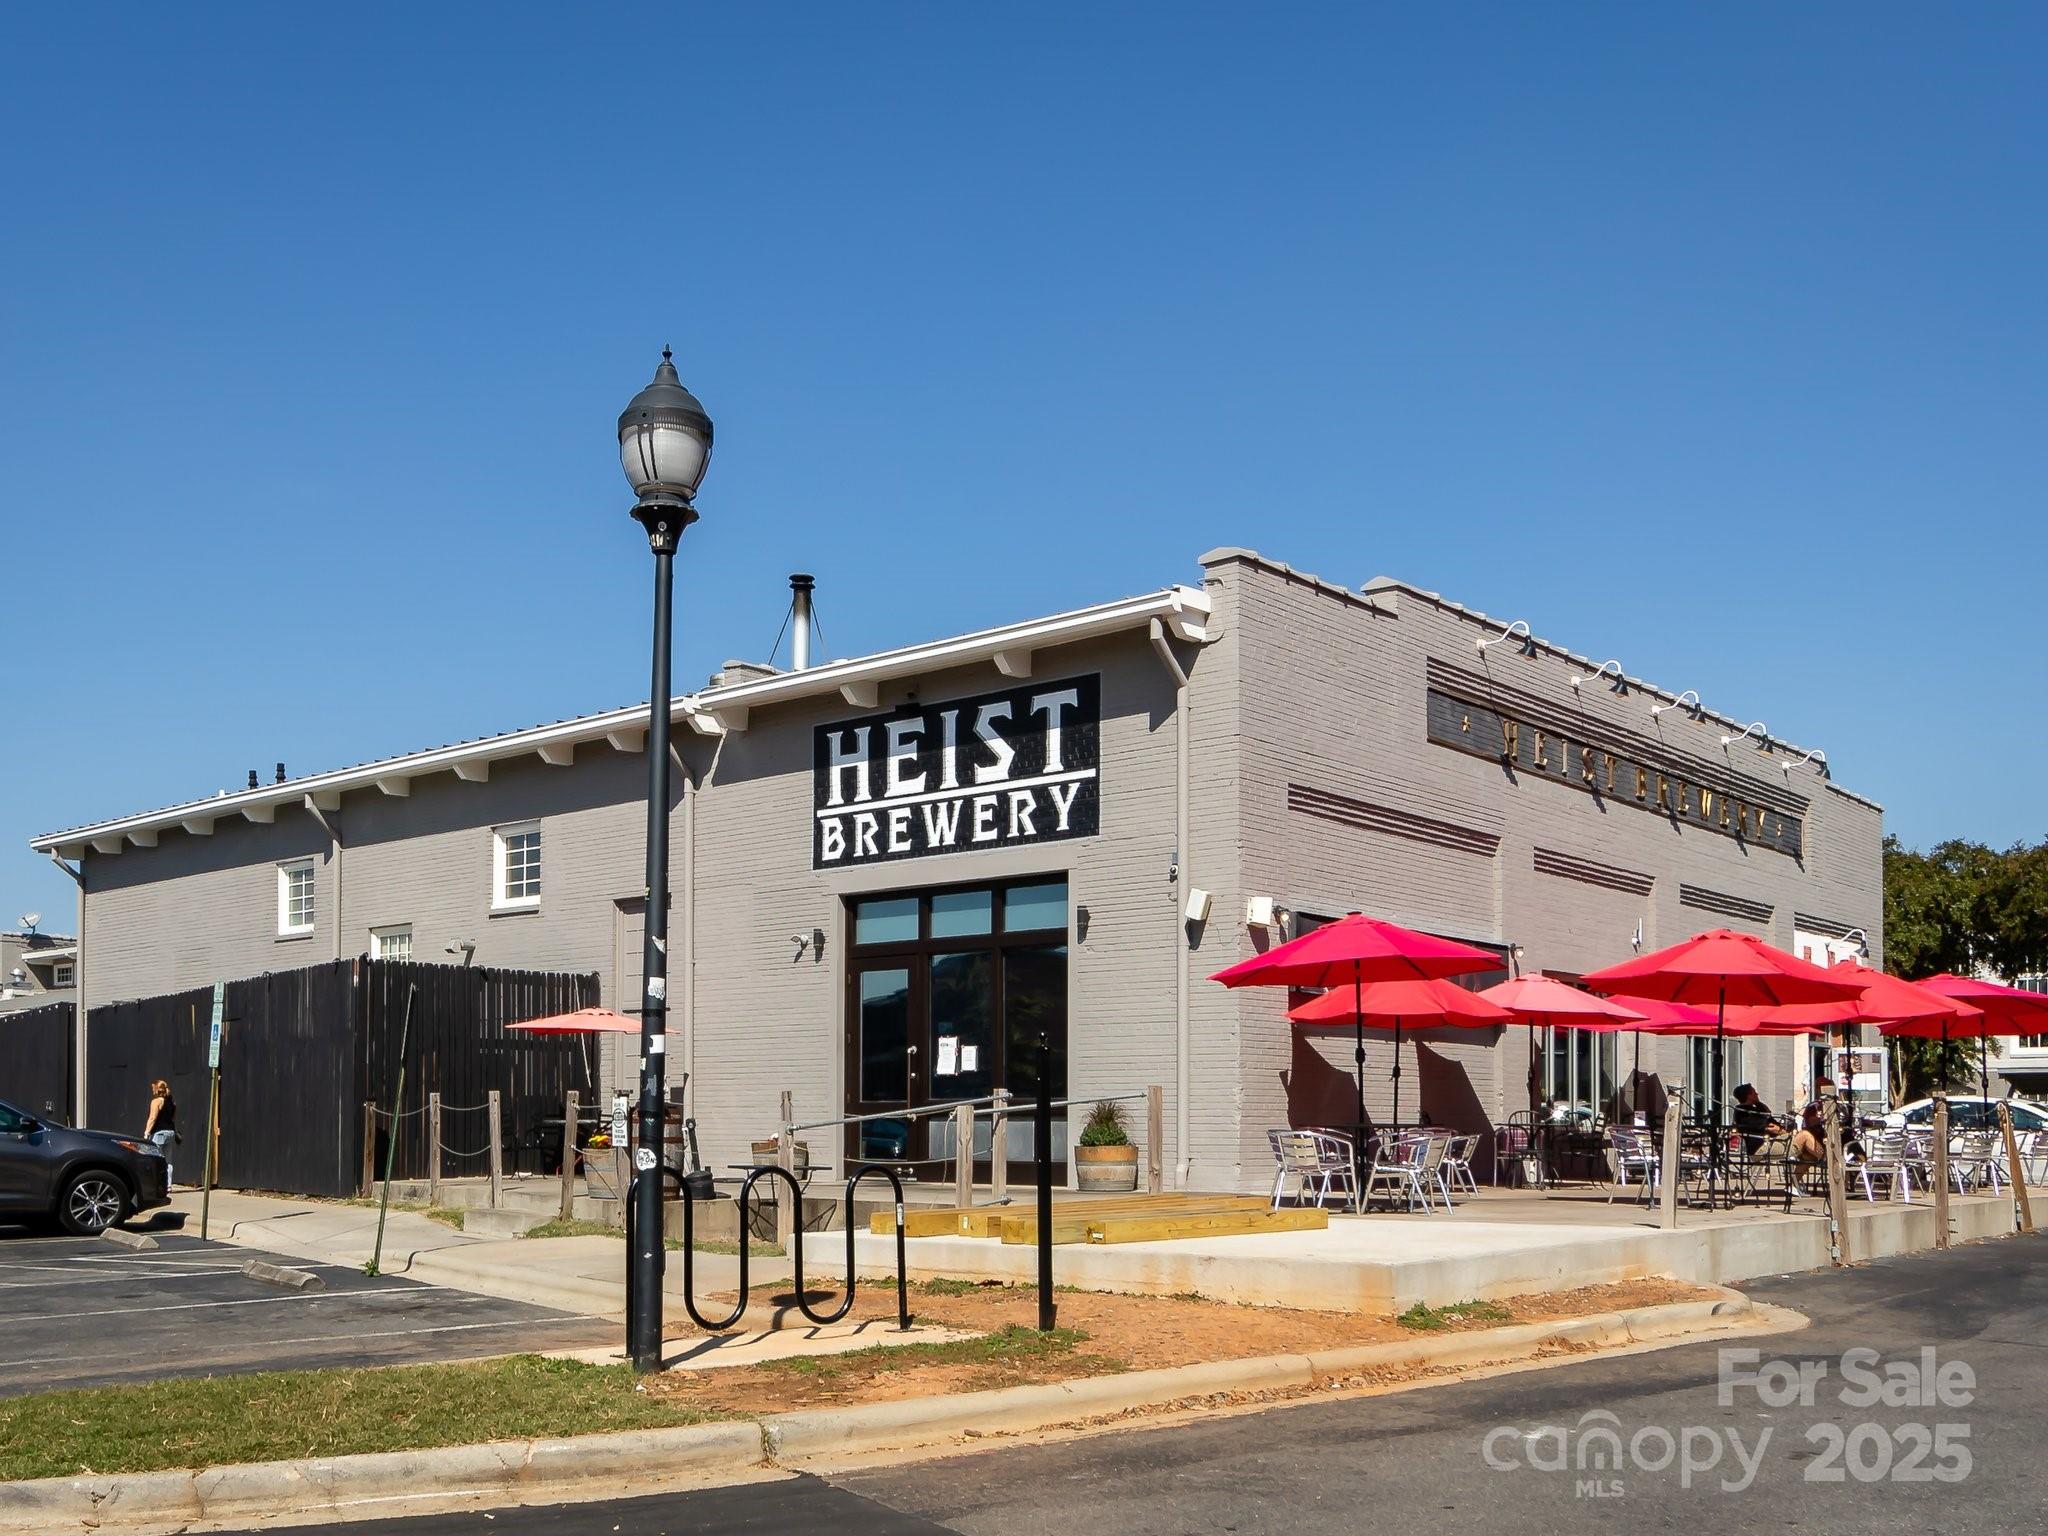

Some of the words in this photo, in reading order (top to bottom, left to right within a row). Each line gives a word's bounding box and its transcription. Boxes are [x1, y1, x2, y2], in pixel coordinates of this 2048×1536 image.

[826, 688, 1078, 806] HEIST
[1503, 719, 1616, 792] HEIST
[1635, 767, 1766, 840] BREWERY
[821, 782, 1082, 861] BREWERY
